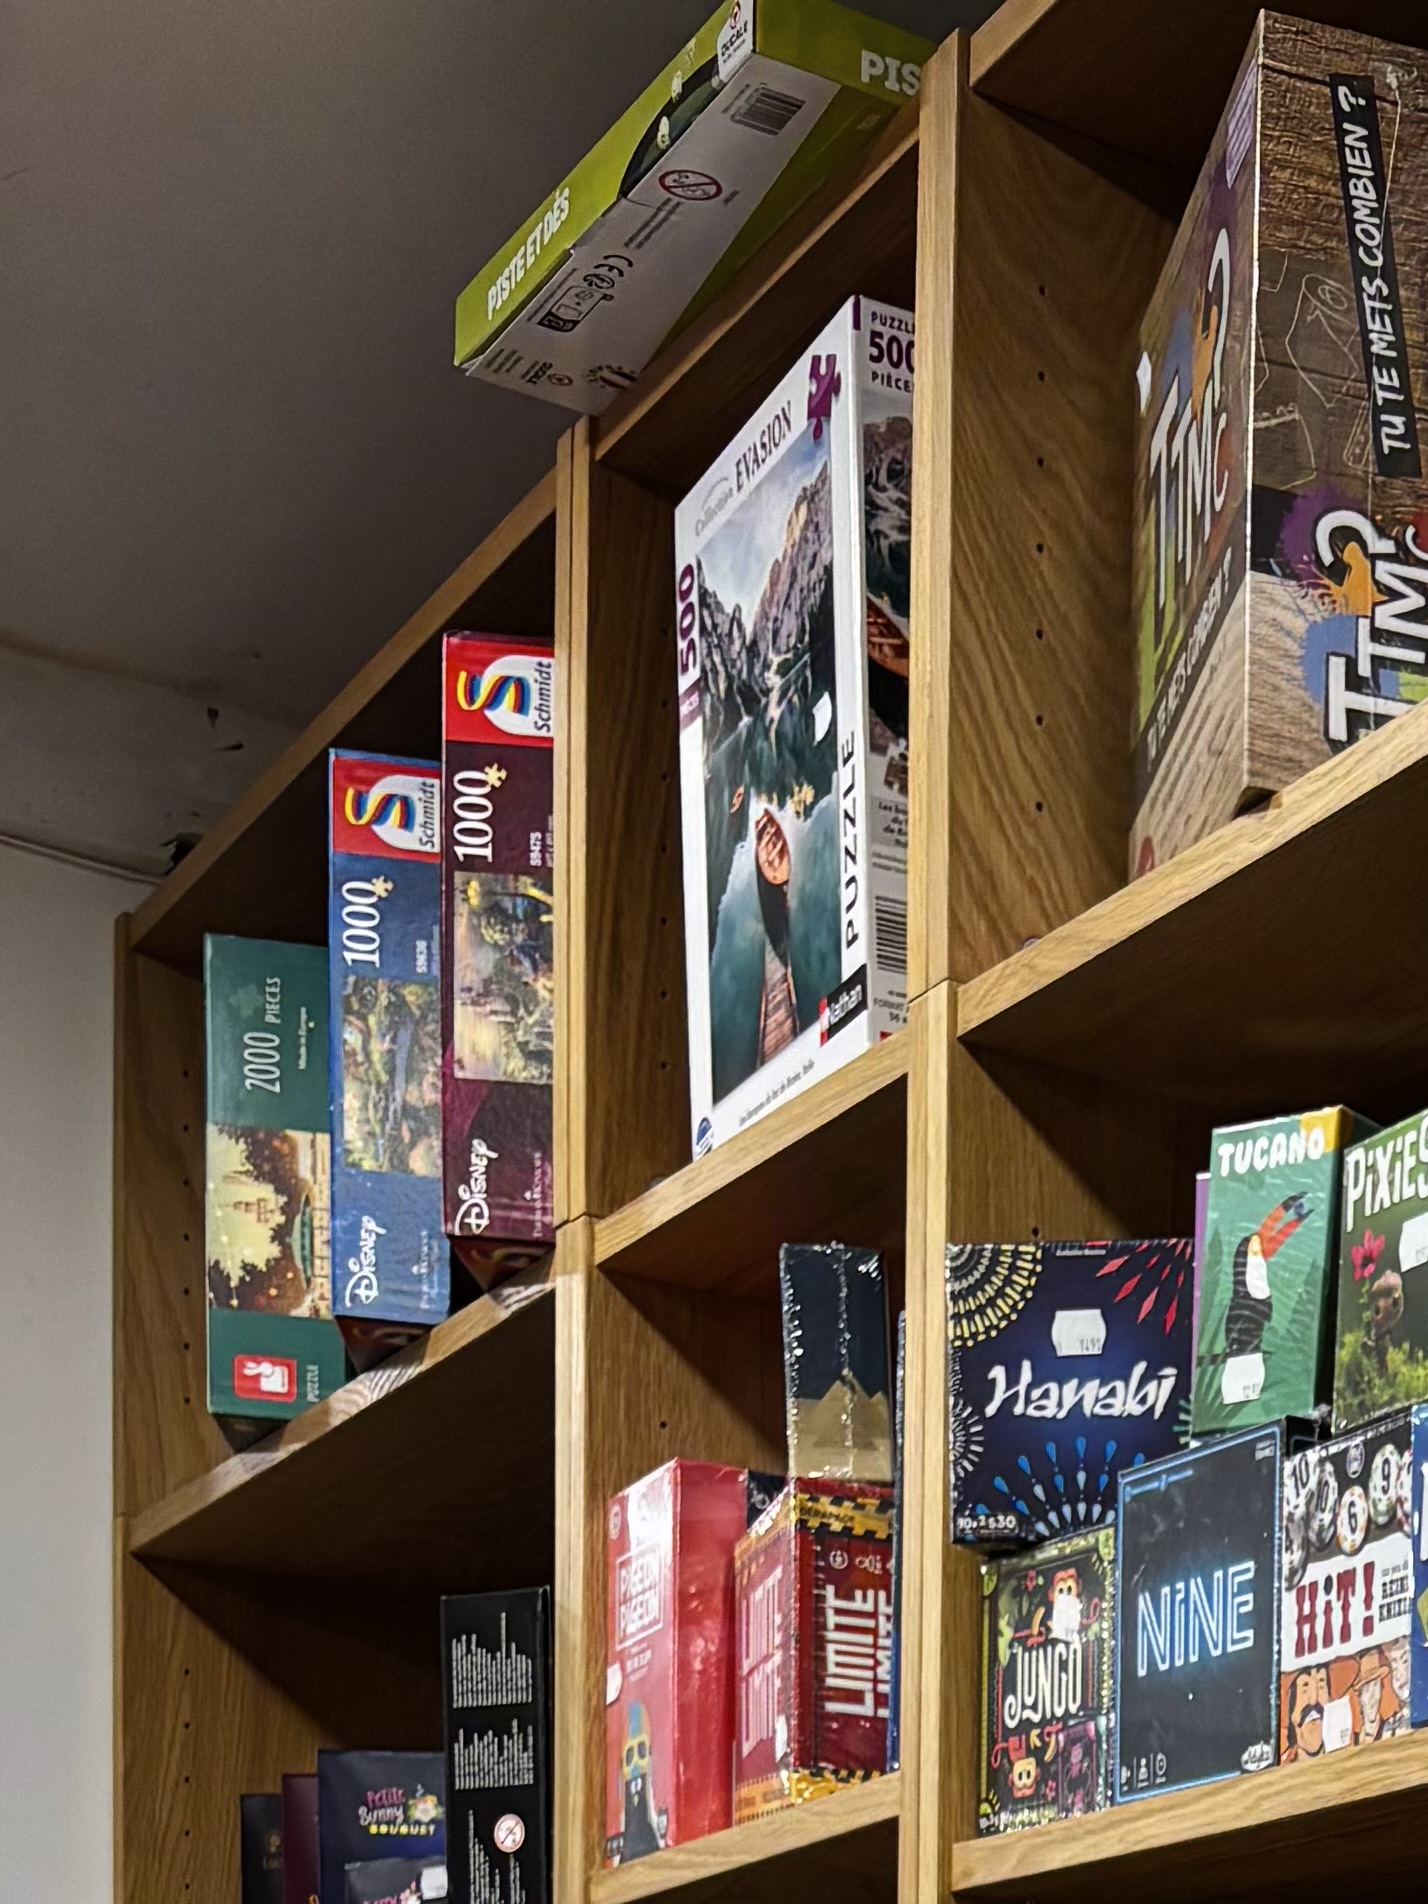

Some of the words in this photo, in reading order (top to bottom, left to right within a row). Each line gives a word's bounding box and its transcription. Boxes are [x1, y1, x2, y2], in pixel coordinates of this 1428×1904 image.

[1345, 122, 1385, 268] COMBIEN
[487, 245, 527, 320] PISTE
[526, 222, 544, 271] ET
[542, 187, 570, 248] DÉS
[1361, 275, 1399, 358] METS
[1373, 366, 1405, 403] TE
[1380, 415, 1412, 455] TU
[532, 658, 553, 734] Schmidt
[419, 779, 438, 852] Schmidt
[453, 769, 494, 864] 1000
[843, 729, 859, 950] PUZZLE
[340, 881, 381, 970] 1000
[244, 1030, 281, 1095] 2000
[265, 975, 282, 1024] PIECES
[1217, 1126, 1327, 1178] TUCANO
[983, 1362, 1179, 1421] Hanabi
[824, 1584, 876, 1718] LIMITE
